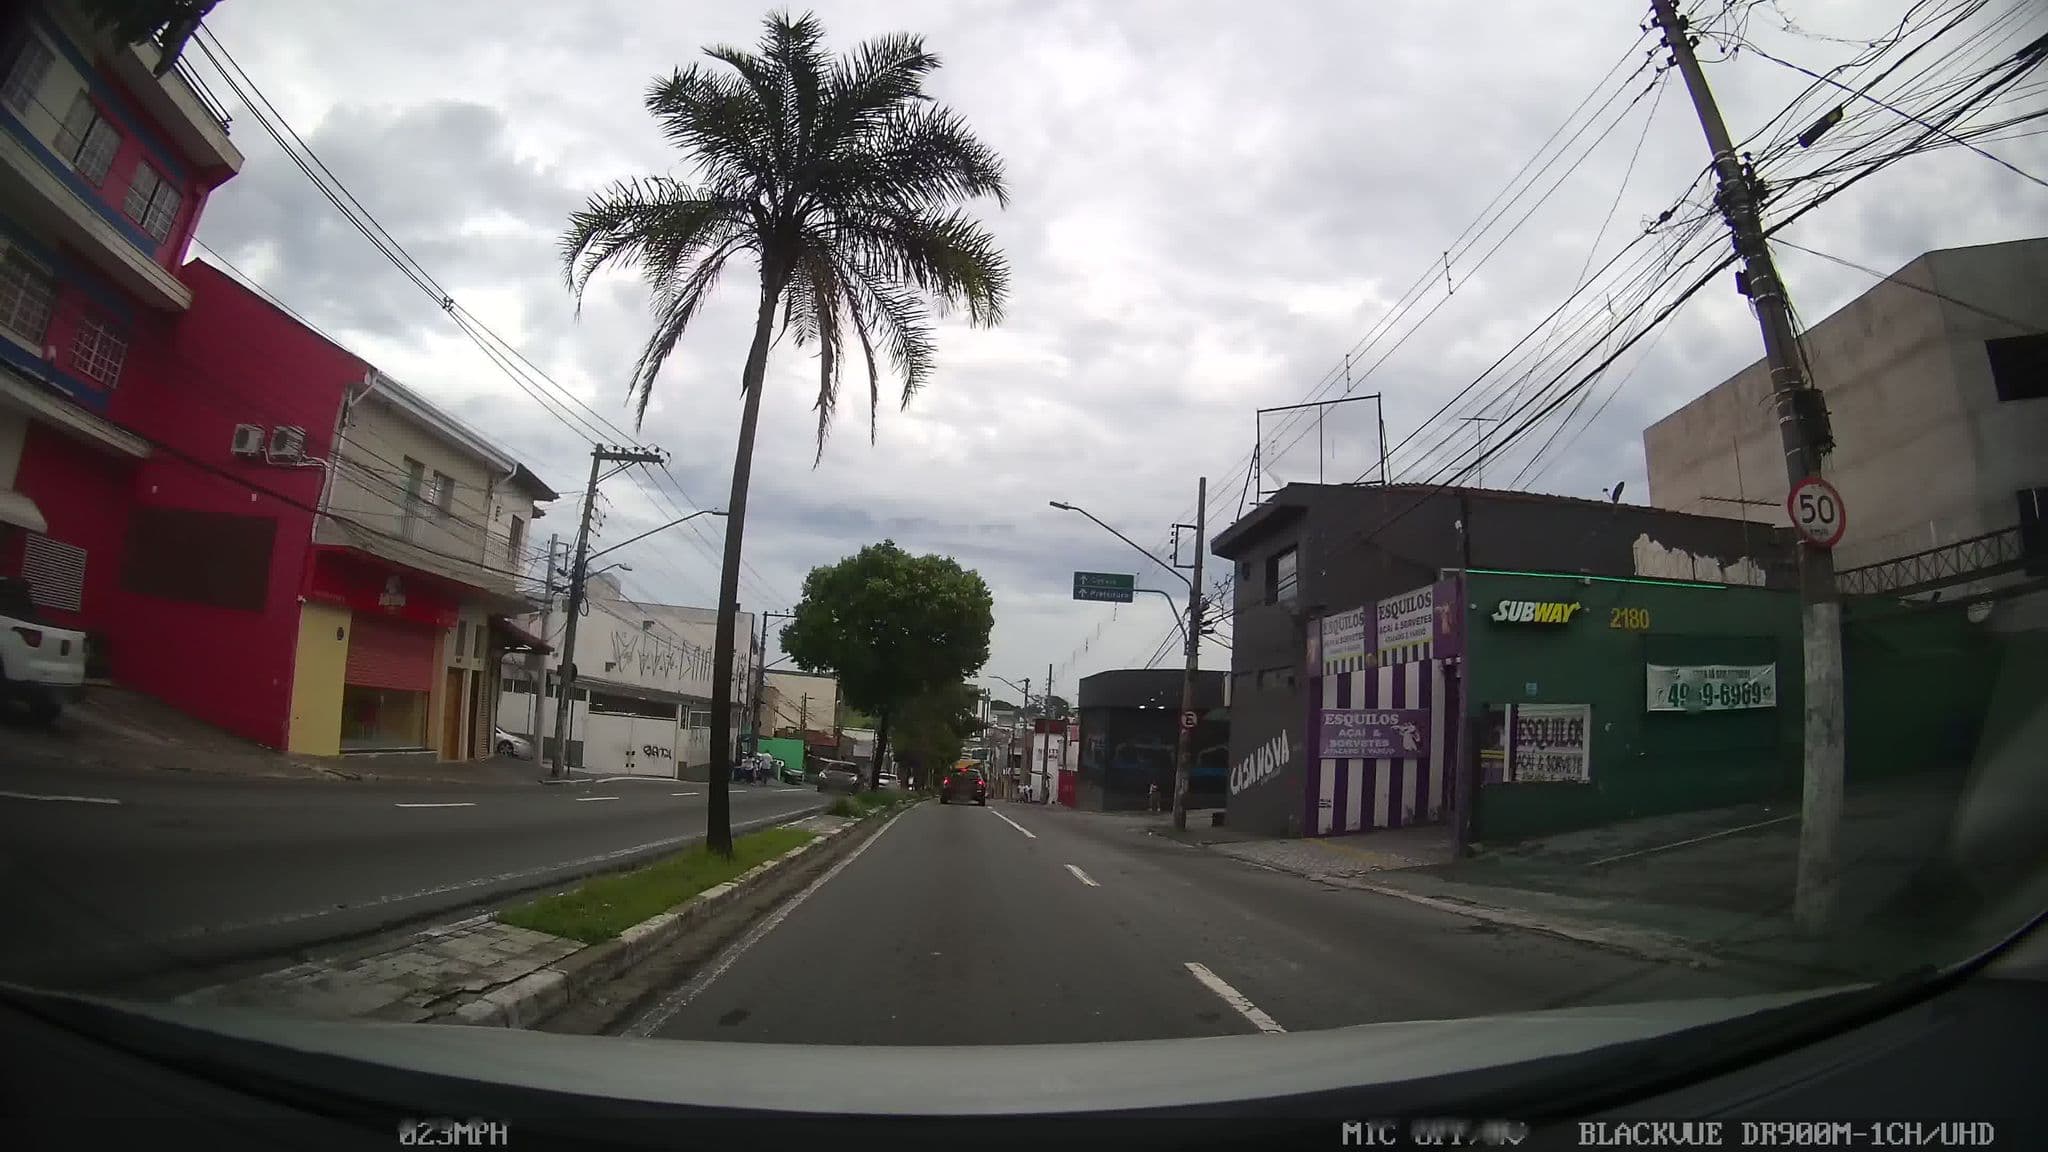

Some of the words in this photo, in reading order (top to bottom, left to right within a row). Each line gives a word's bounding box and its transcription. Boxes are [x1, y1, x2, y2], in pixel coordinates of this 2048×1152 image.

[1800, 494, 1835, 524] 50
[1378, 591, 1433, 621] ESQUILOS
[1492, 600, 1581, 623] SUBWAY
[1610, 608, 1650, 630] 2180
[1324, 713, 1399, 727] ESQUILOS
